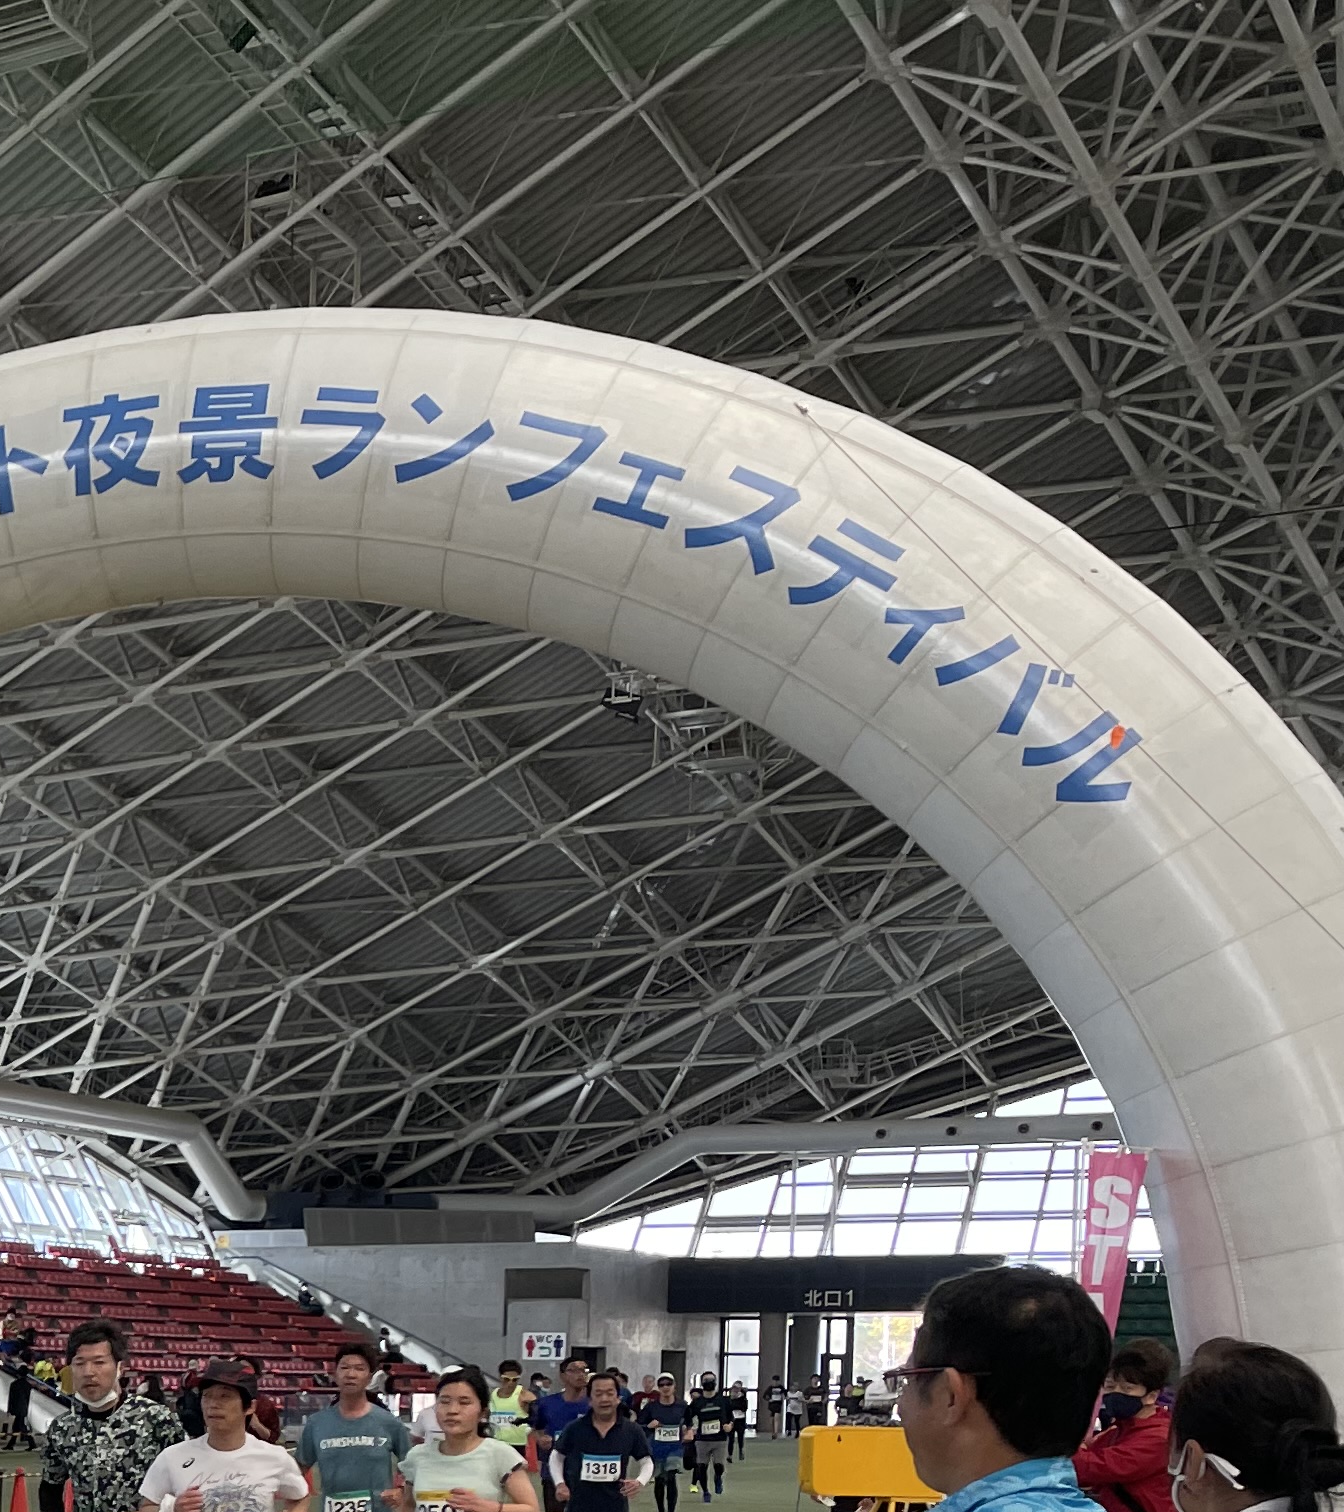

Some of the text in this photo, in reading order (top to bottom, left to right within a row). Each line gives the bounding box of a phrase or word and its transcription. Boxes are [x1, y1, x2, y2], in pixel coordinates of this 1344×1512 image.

[1086, 1175, 1133, 1316] ST
[803, 1289, 854, 1307] 北口1
[535, 1334, 553, 1344] WC
[585, 1462, 618, 1475] 1318
